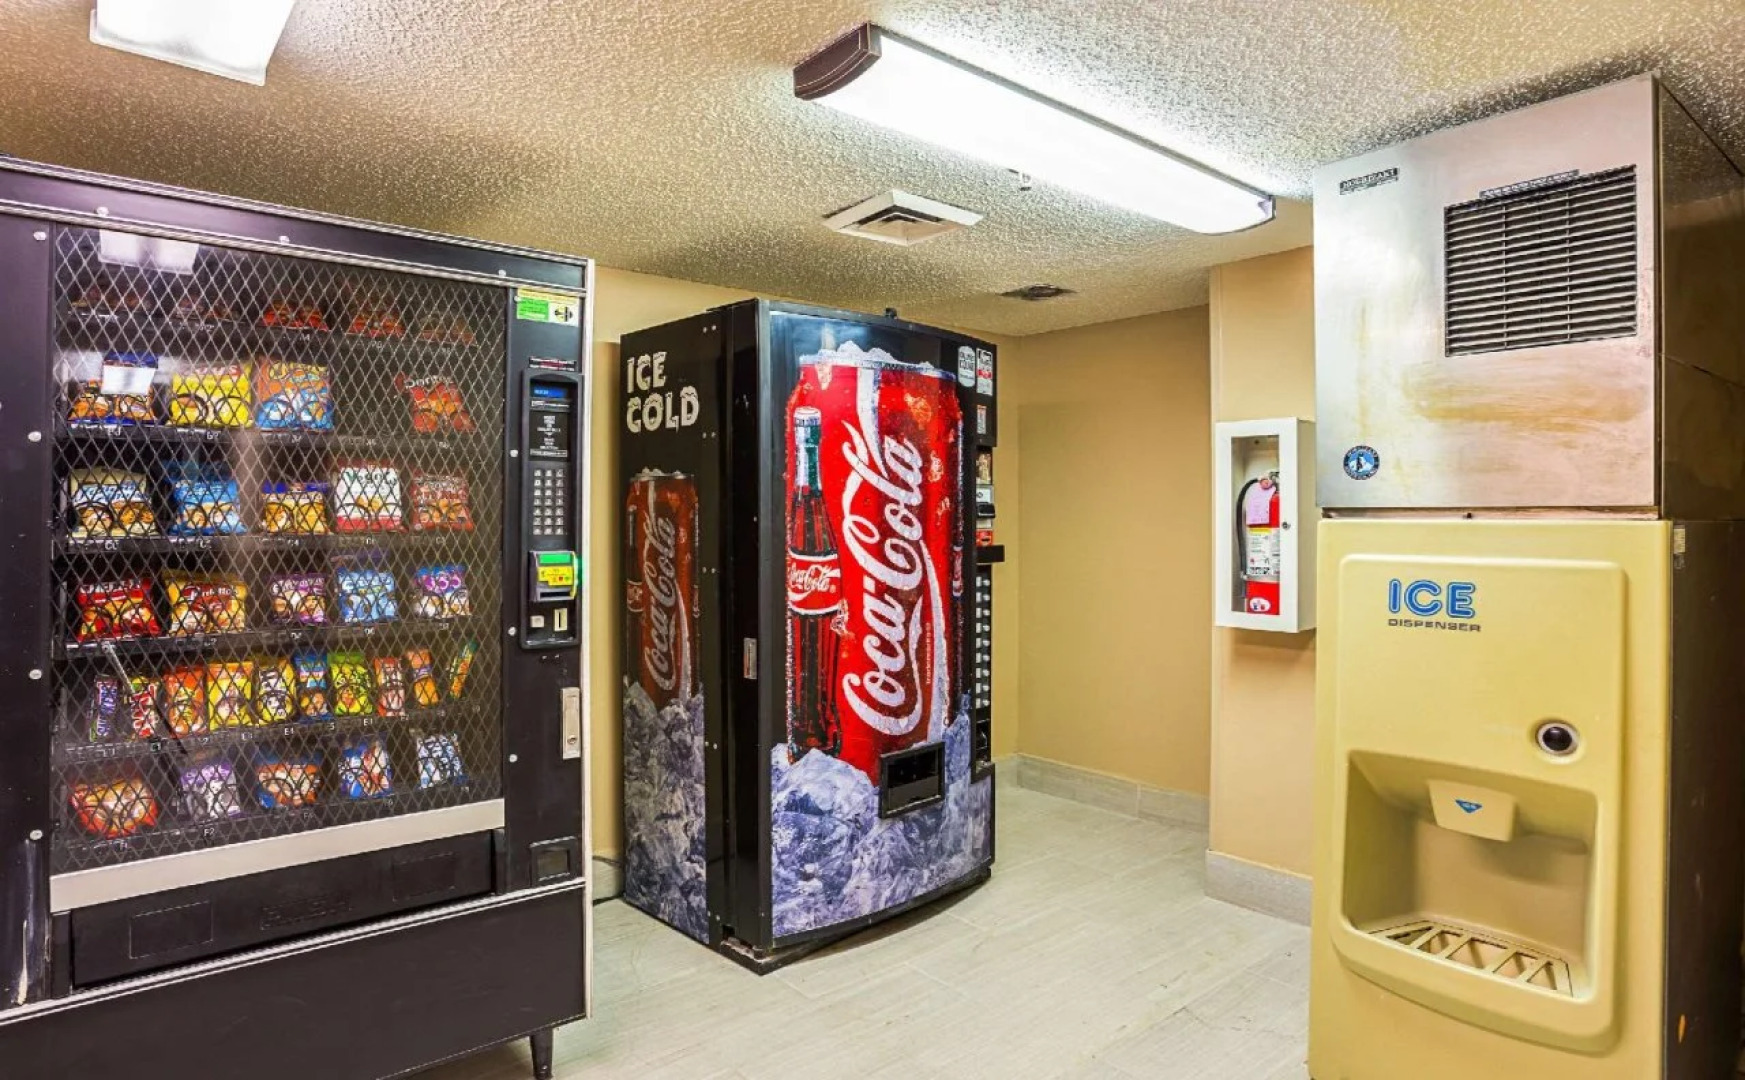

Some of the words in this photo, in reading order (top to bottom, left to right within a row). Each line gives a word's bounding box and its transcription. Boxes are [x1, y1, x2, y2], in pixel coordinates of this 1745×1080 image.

[627, 351, 667, 393] ICE
[626, 385, 700, 433] COLD
[842, 420, 923, 736] Coca-Cola
[1388, 578, 1475, 619] ICE
[1388, 618, 1482, 632] DISPENSER
